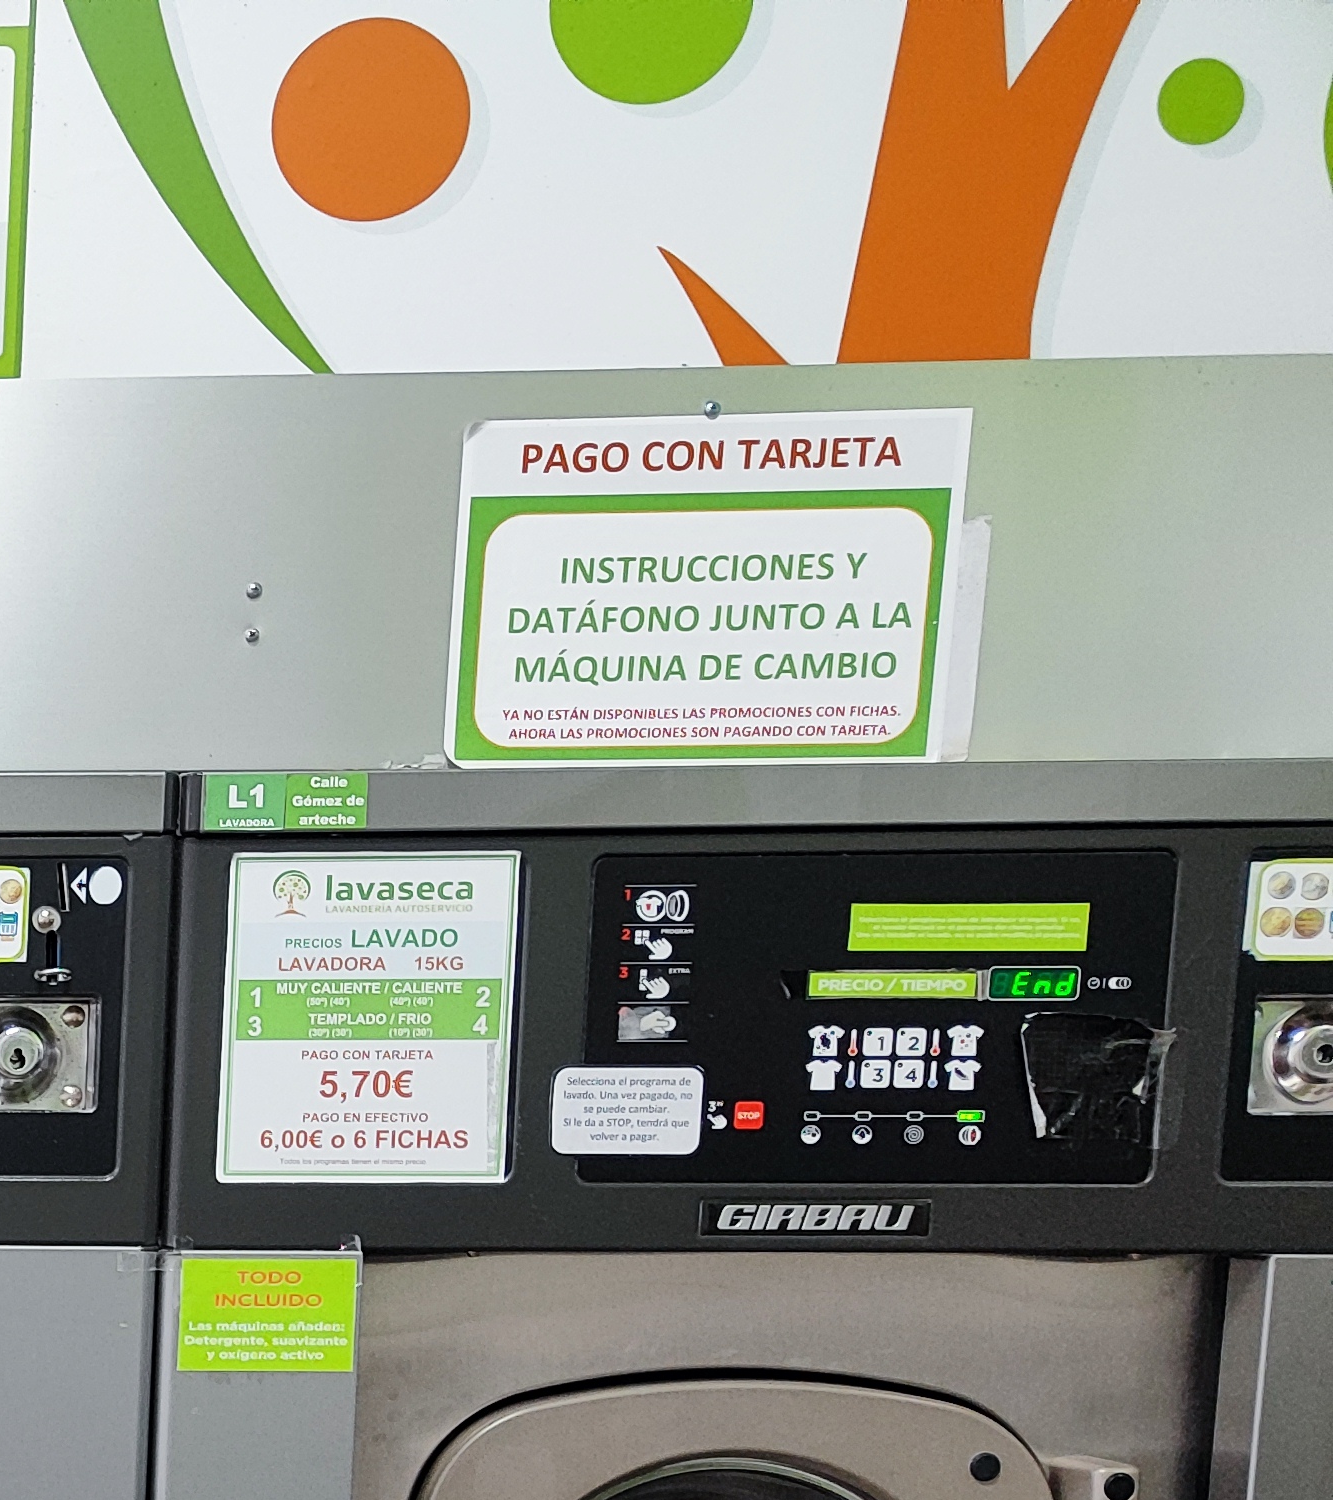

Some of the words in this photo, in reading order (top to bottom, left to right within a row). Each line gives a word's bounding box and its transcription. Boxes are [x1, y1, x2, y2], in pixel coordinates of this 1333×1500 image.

[522, 442, 629, 473] PAGO
[643, 440, 724, 471] CON
[738, 437, 901, 469] TARJETA
[561, 553, 834, 584] INSTRUCCIONES
[847, 553, 867, 579] Y
[509, 600, 699, 633] DATÁFONO
[709, 603, 825, 631] JUNTO
[836, 603, 859, 629] A
[873, 602, 911, 628] LA
[515, 649, 686, 686] MÁQUINA
[699, 655, 742, 680] DE
[755, 652, 896, 680] CAMBIO
[503, 710, 519, 720] YA
[524, 710, 543, 720] NO
[548, 707, 589, 720] ESTÁN
[594, 709, 678, 720] DISPONIBLES
[683, 708, 705, 719] LAS
[710, 707, 811, 718] PROMOCIONES
[816, 706, 845, 717] CON
[850, 706, 900, 716] FICHAS.
[227, 783, 265, 809] L1
[326, 875, 473, 901] lavaseca
[1012, 971, 1073, 996] End
[320, 1070, 413, 1103] 5,70€
[738, 1111, 760, 1119] STOP
[717, 1205, 915, 1230] GIRBAU
[237, 1271, 301, 1285] TODO
[215, 1294, 322, 1308] INCLUIDO
